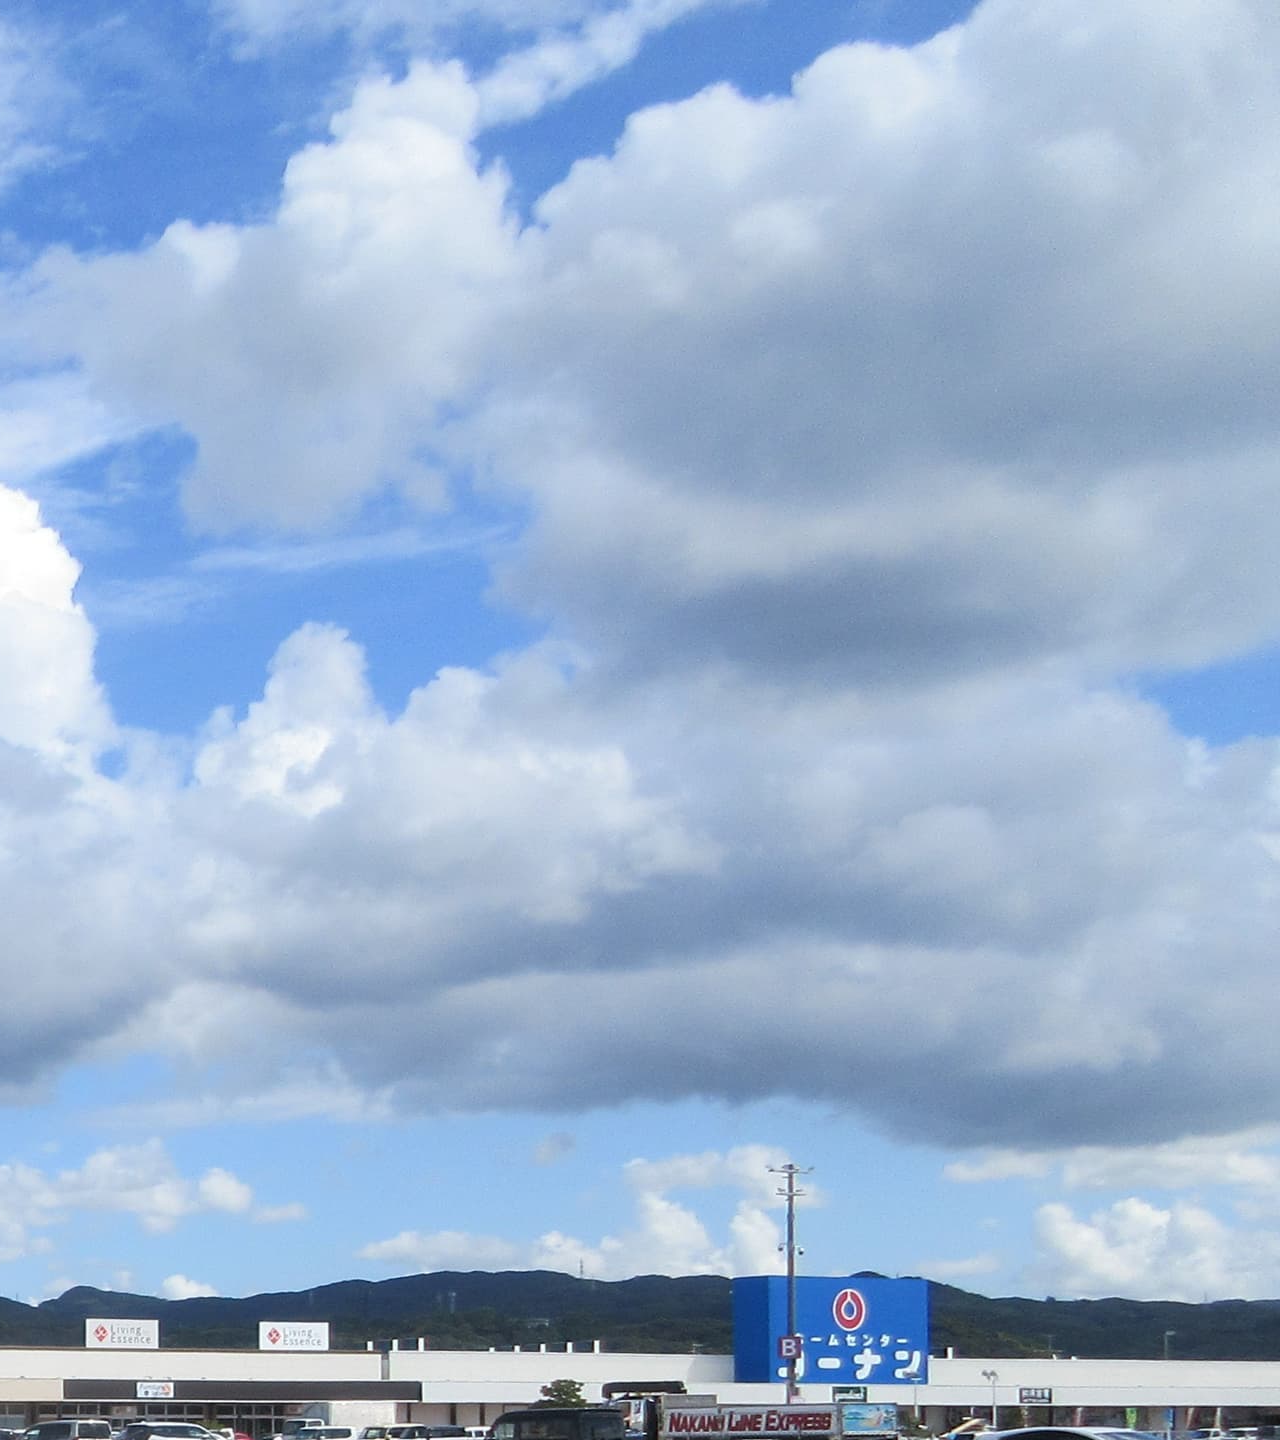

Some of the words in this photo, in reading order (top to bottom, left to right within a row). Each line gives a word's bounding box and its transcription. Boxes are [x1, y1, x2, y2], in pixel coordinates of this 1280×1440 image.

[110, 1324, 142, 1337] Living
[283, 1327, 313, 1339] Living
[110, 1333, 152, 1344] Essence
[283, 1338, 322, 1346] Essence
[781, 1338, 797, 1356] B
[765, 1410, 833, 1431] EXPRESS
